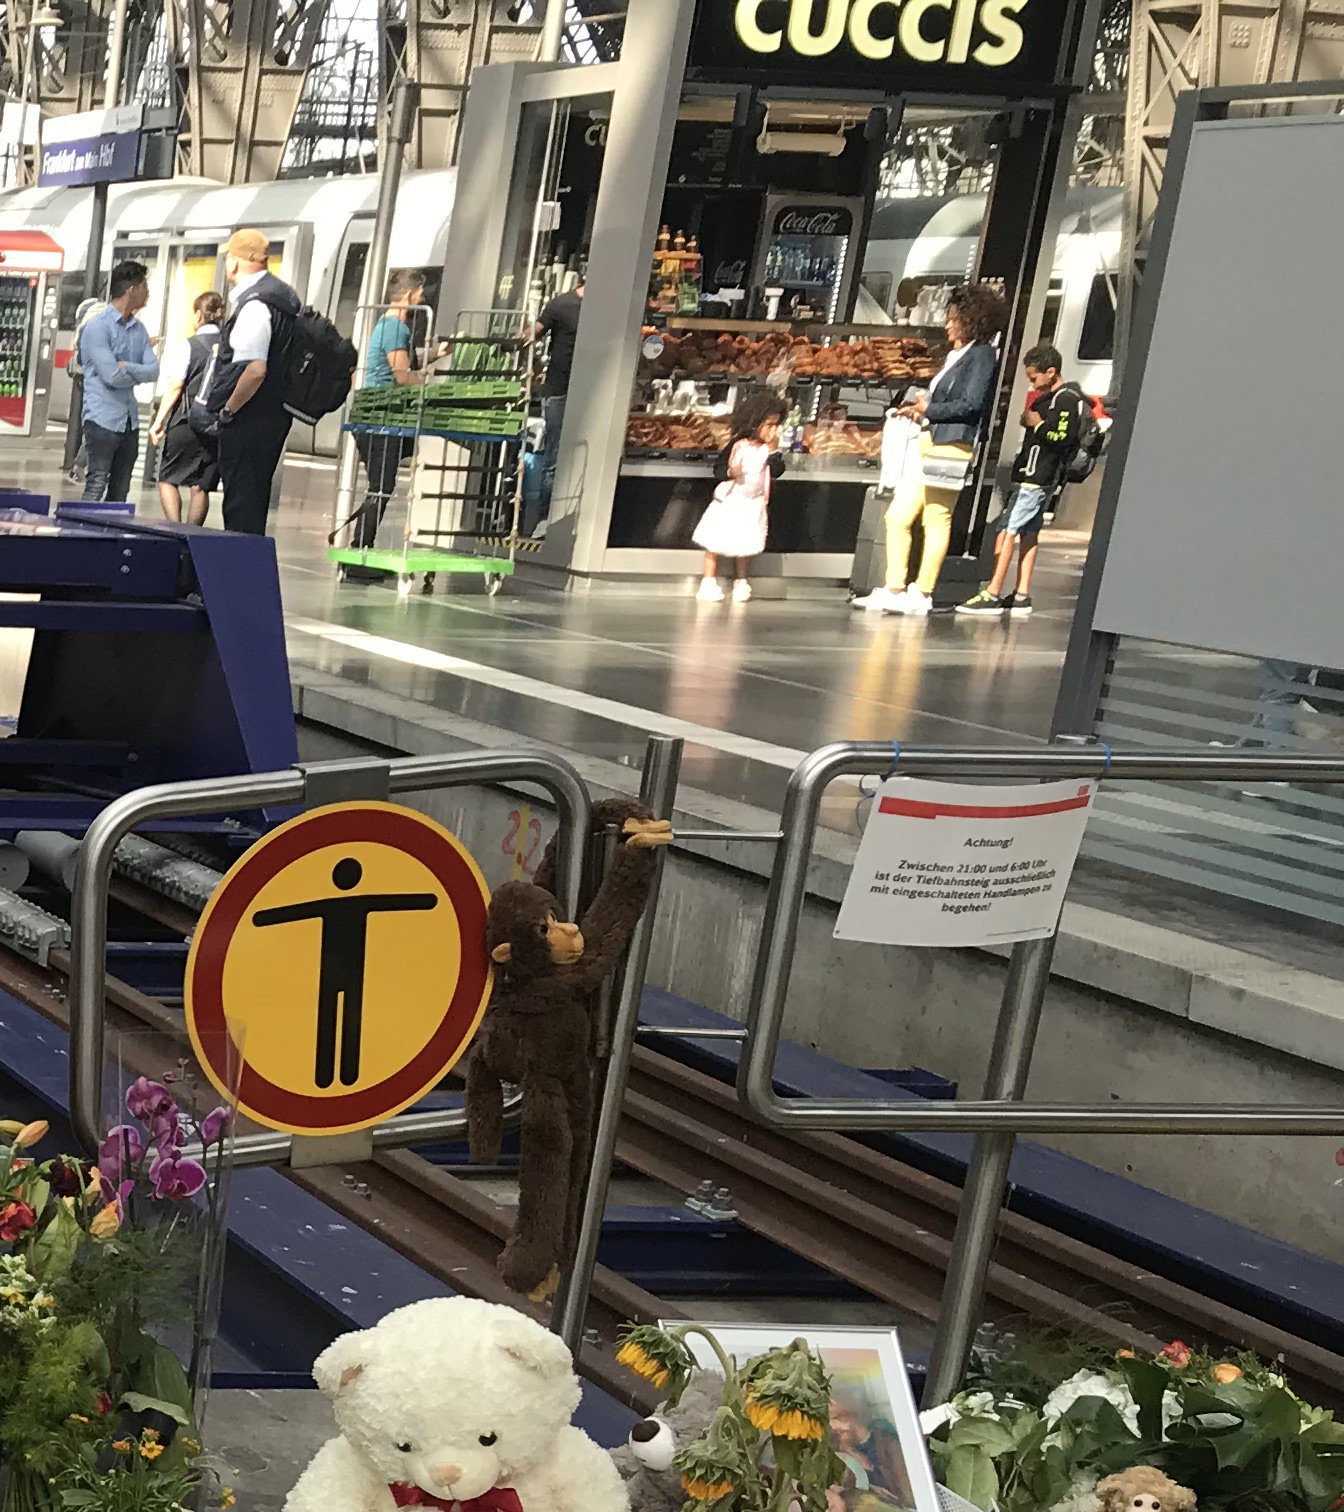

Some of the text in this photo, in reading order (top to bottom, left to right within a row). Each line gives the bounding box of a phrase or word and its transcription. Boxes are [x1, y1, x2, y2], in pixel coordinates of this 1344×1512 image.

[42, 148, 76, 175] Frankfurt
[963, 837, 1014, 849] Achtung!
[898, 858, 1048, 874] Zwischen 21:00 und 6:00 Uhr
[874, 870, 890, 881] ist
[893, 873, 913, 883] der
[916, 875, 991, 888] Tiefbahnsteig
[870, 884, 890, 895] mit
[892, 887, 981, 899] eingeschalteten
[941, 902, 993, 915] begehen!
